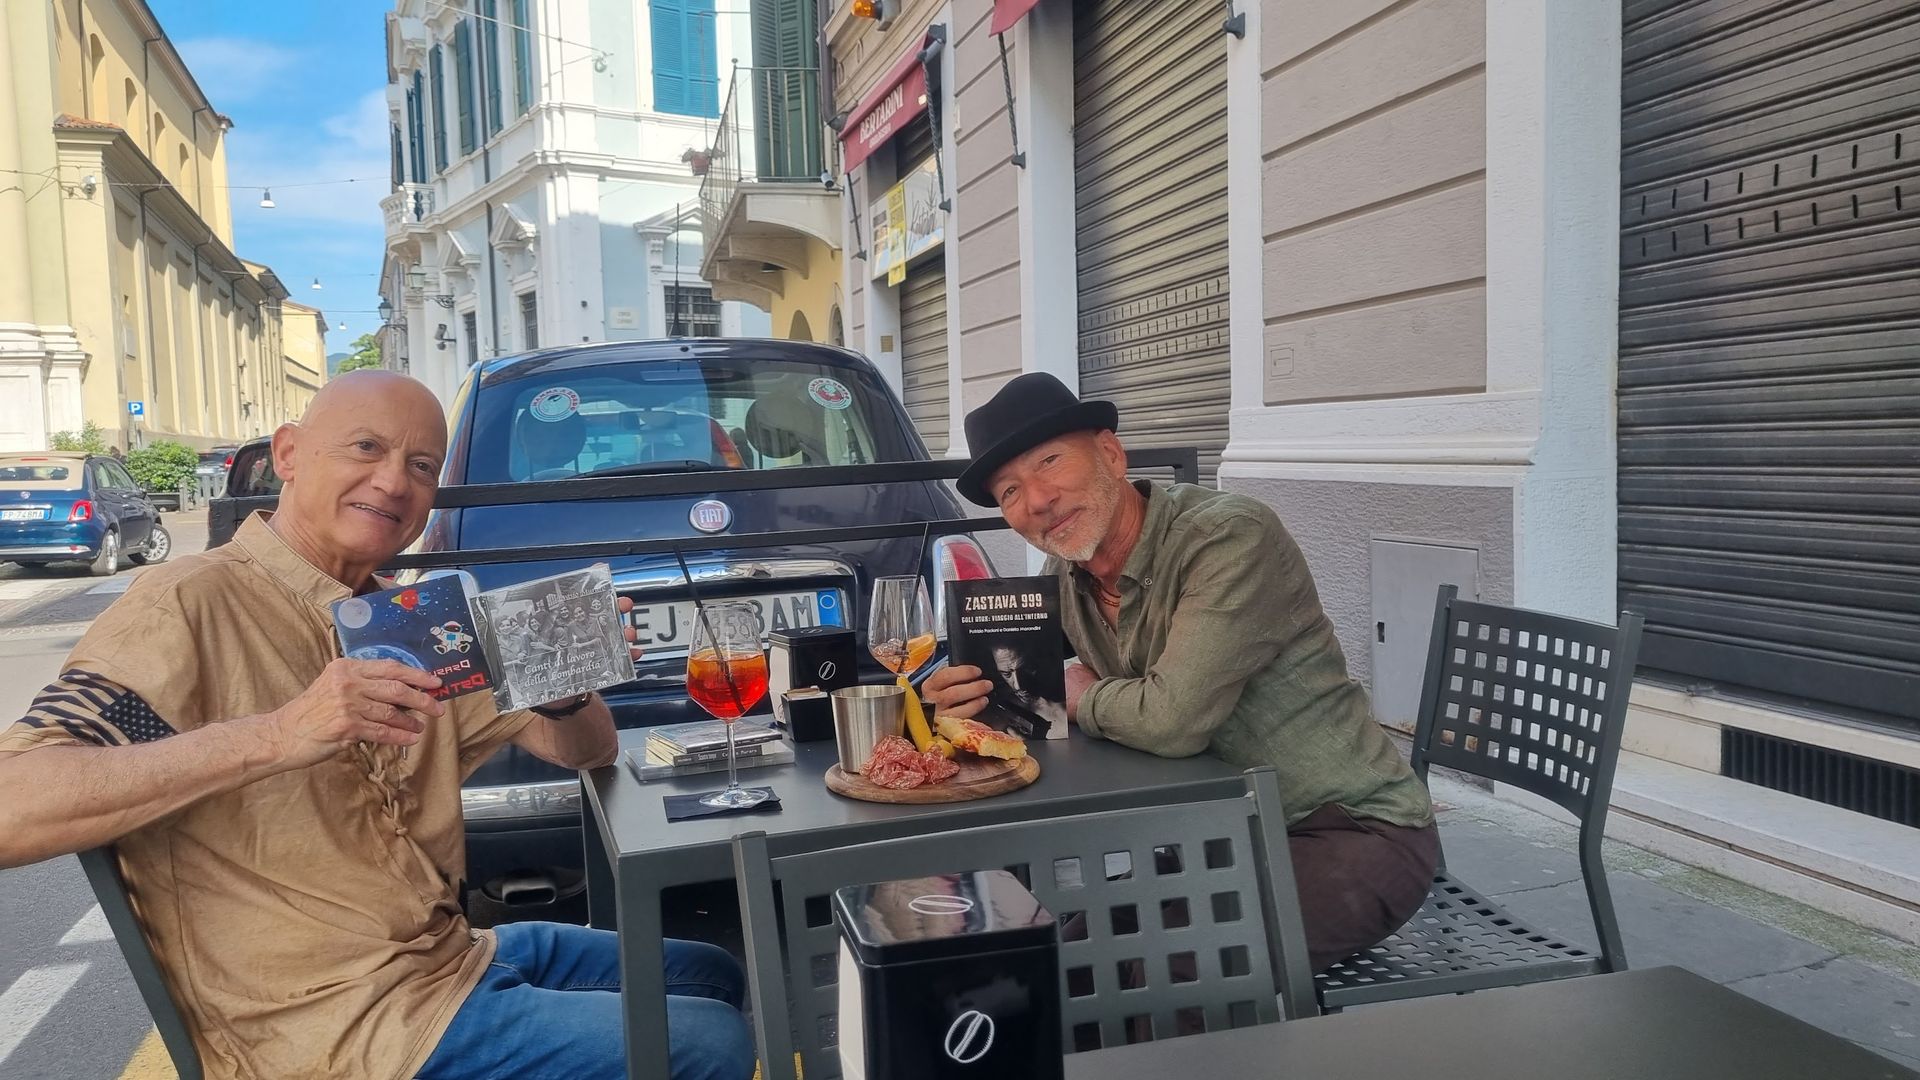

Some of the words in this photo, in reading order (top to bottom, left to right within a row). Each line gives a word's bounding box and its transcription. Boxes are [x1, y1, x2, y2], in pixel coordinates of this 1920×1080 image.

[860, 83, 904, 144] BERTARINI
[131, 403, 141, 415] P
[700, 508, 722, 523] FIAT
[965, 594, 1018, 611] ZASTAVA
[1021, 593, 1042, 608] 999
[630, 605, 677, 646] EJ
[524, 656, 552, 675] Canti
[554, 651, 565, 667] di
[567, 651, 595, 664] lavoro
[524, 672, 548, 687] della
[551, 660, 601, 680] Lombardia
